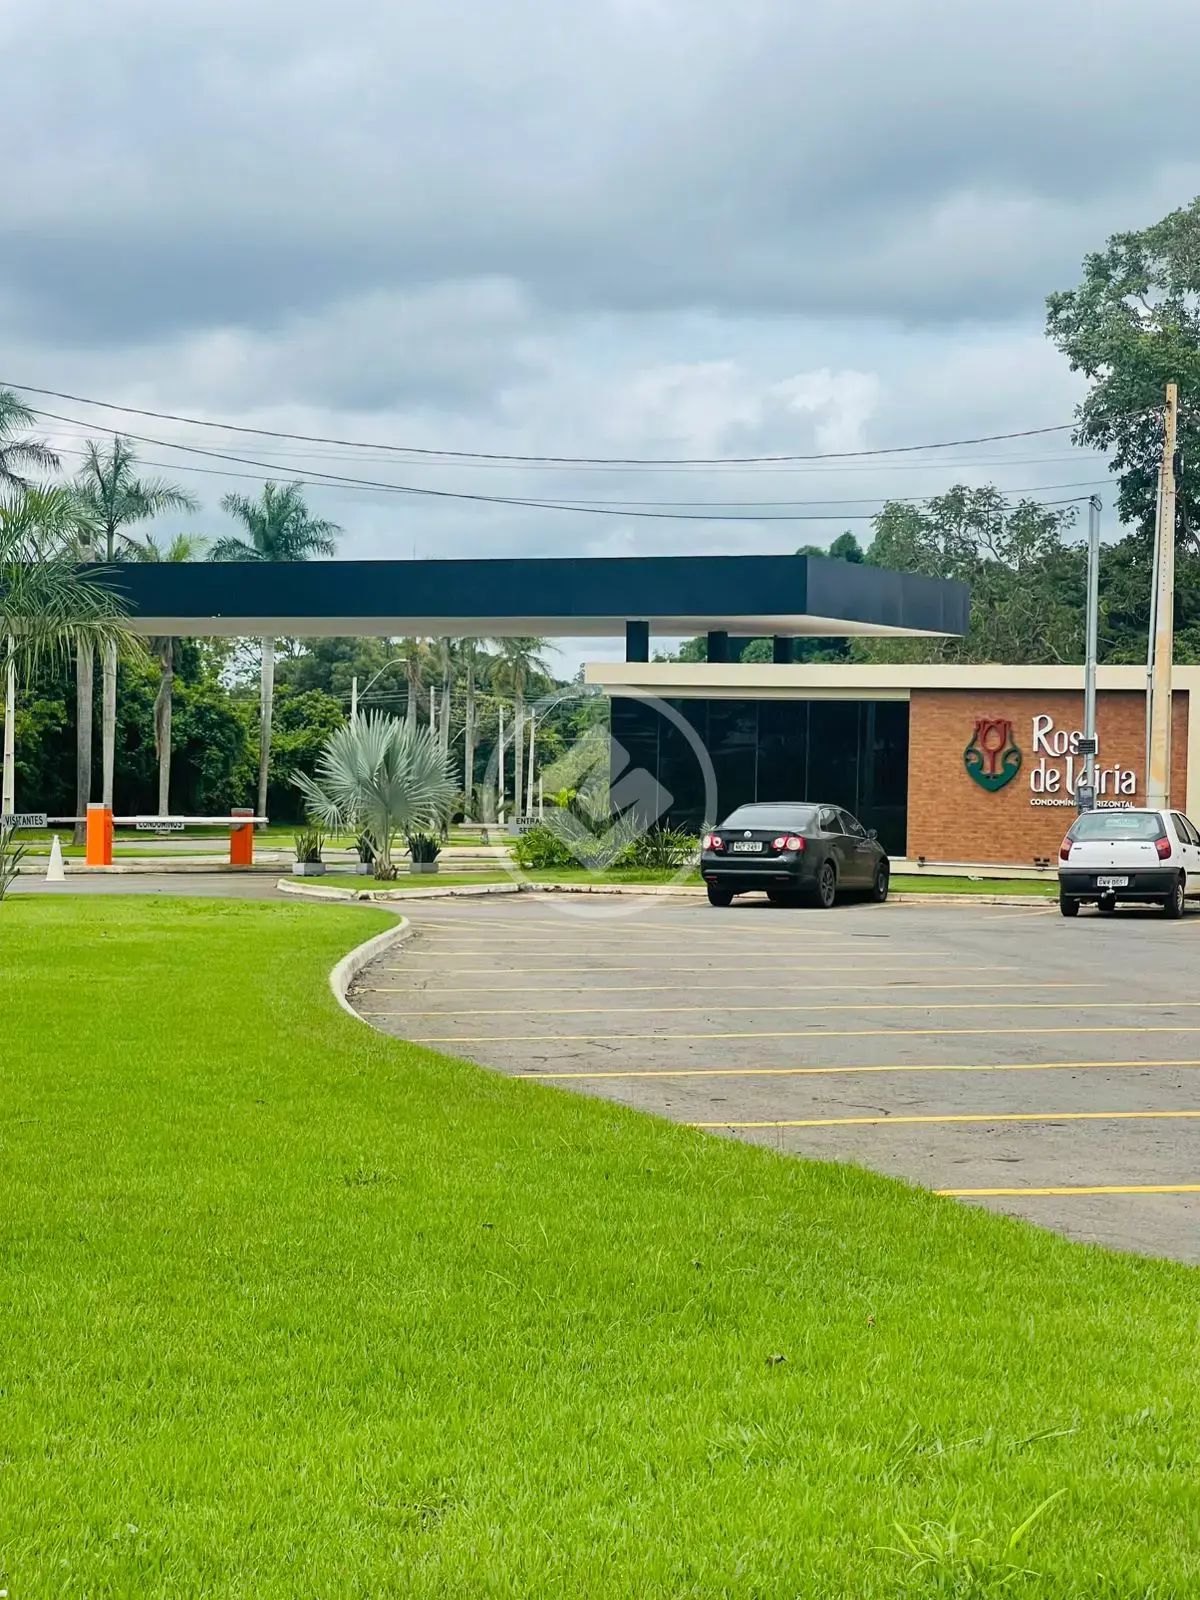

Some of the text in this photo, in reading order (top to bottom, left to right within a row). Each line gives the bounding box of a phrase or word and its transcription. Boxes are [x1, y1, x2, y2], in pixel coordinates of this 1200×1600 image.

[1030, 756, 1136, 796] de Liria
[1096, 800, 1136, 809] RIZONTAL
[5, 815, 44, 826] VISITANTES
